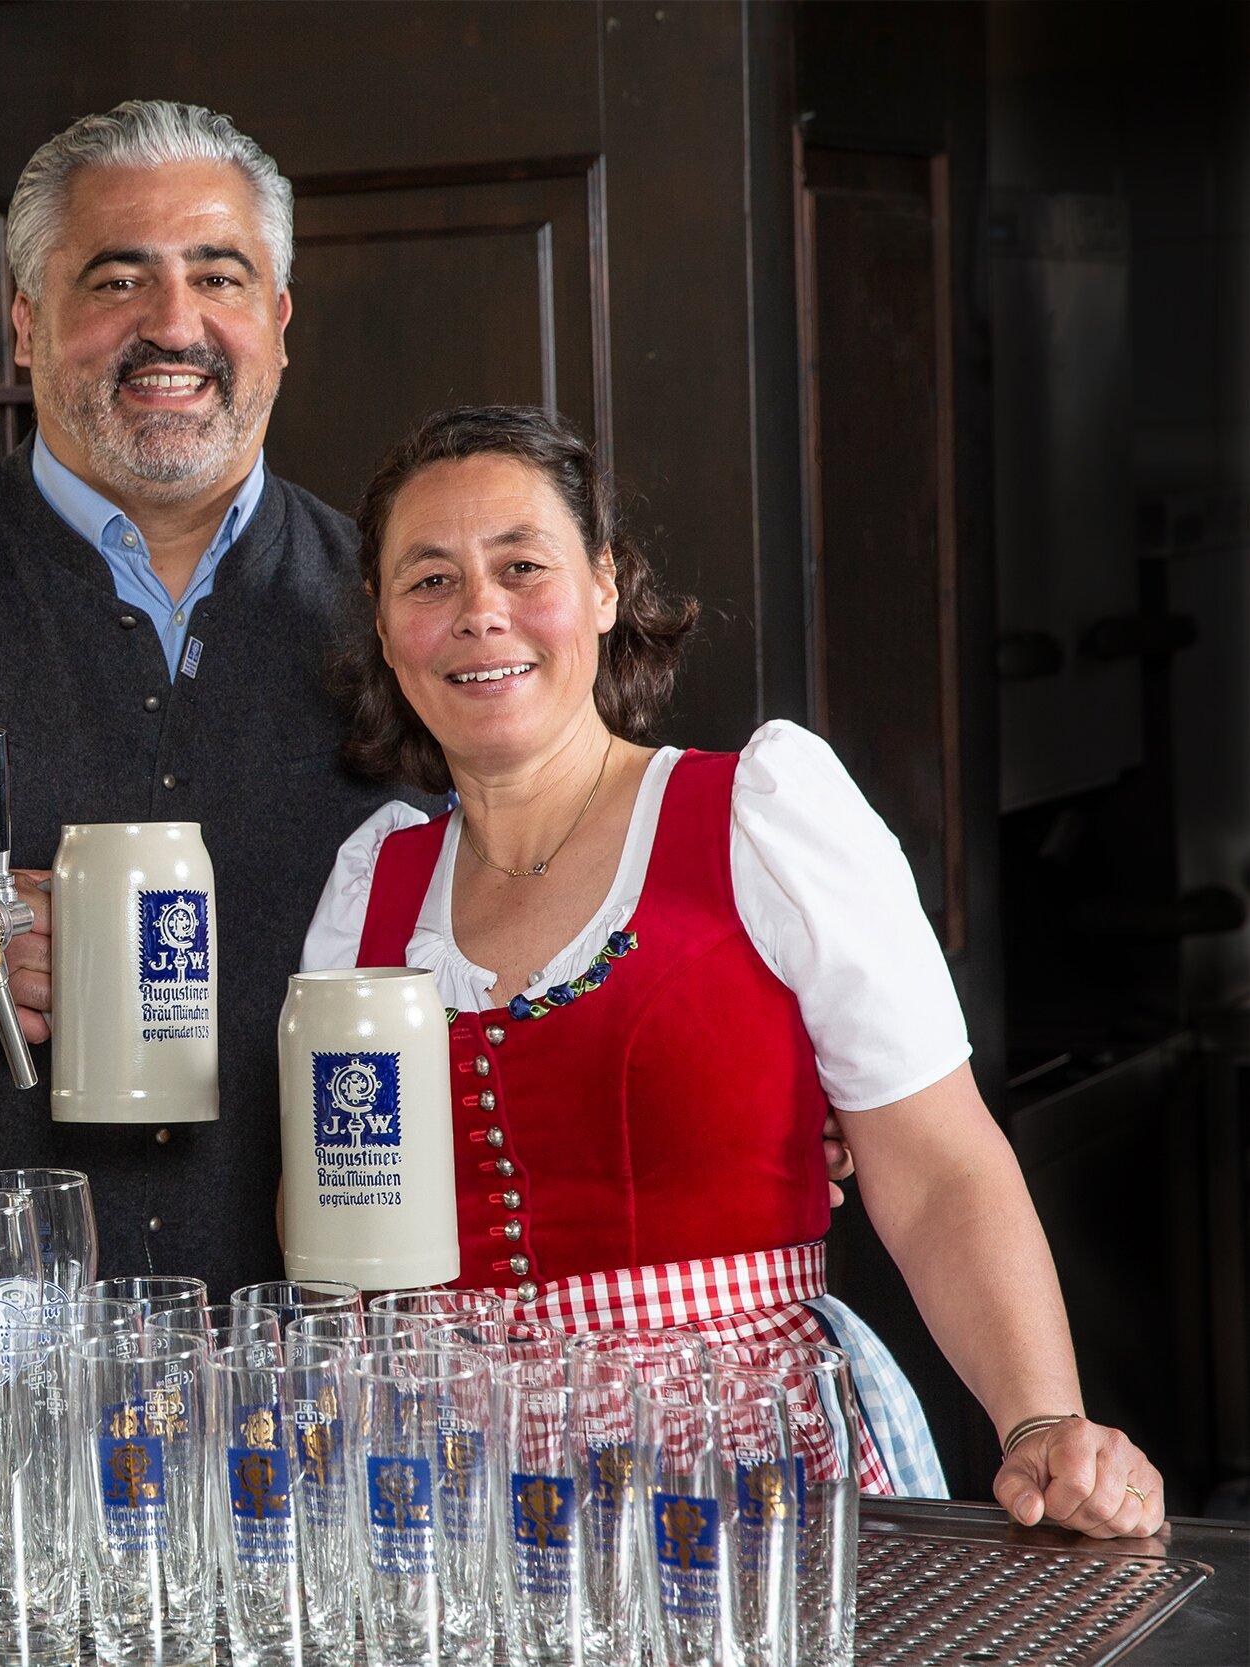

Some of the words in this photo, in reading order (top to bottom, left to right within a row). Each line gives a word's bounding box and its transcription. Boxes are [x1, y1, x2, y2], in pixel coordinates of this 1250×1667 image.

[148, 951, 173, 971] J.
[142, 1025, 193, 1042] gegründet
[323, 1115, 347, 1135] J.
[365, 1114, 394, 1134] W.
[319, 1191, 374, 1208] gegründet
[376, 1191, 402, 1206] 1328
